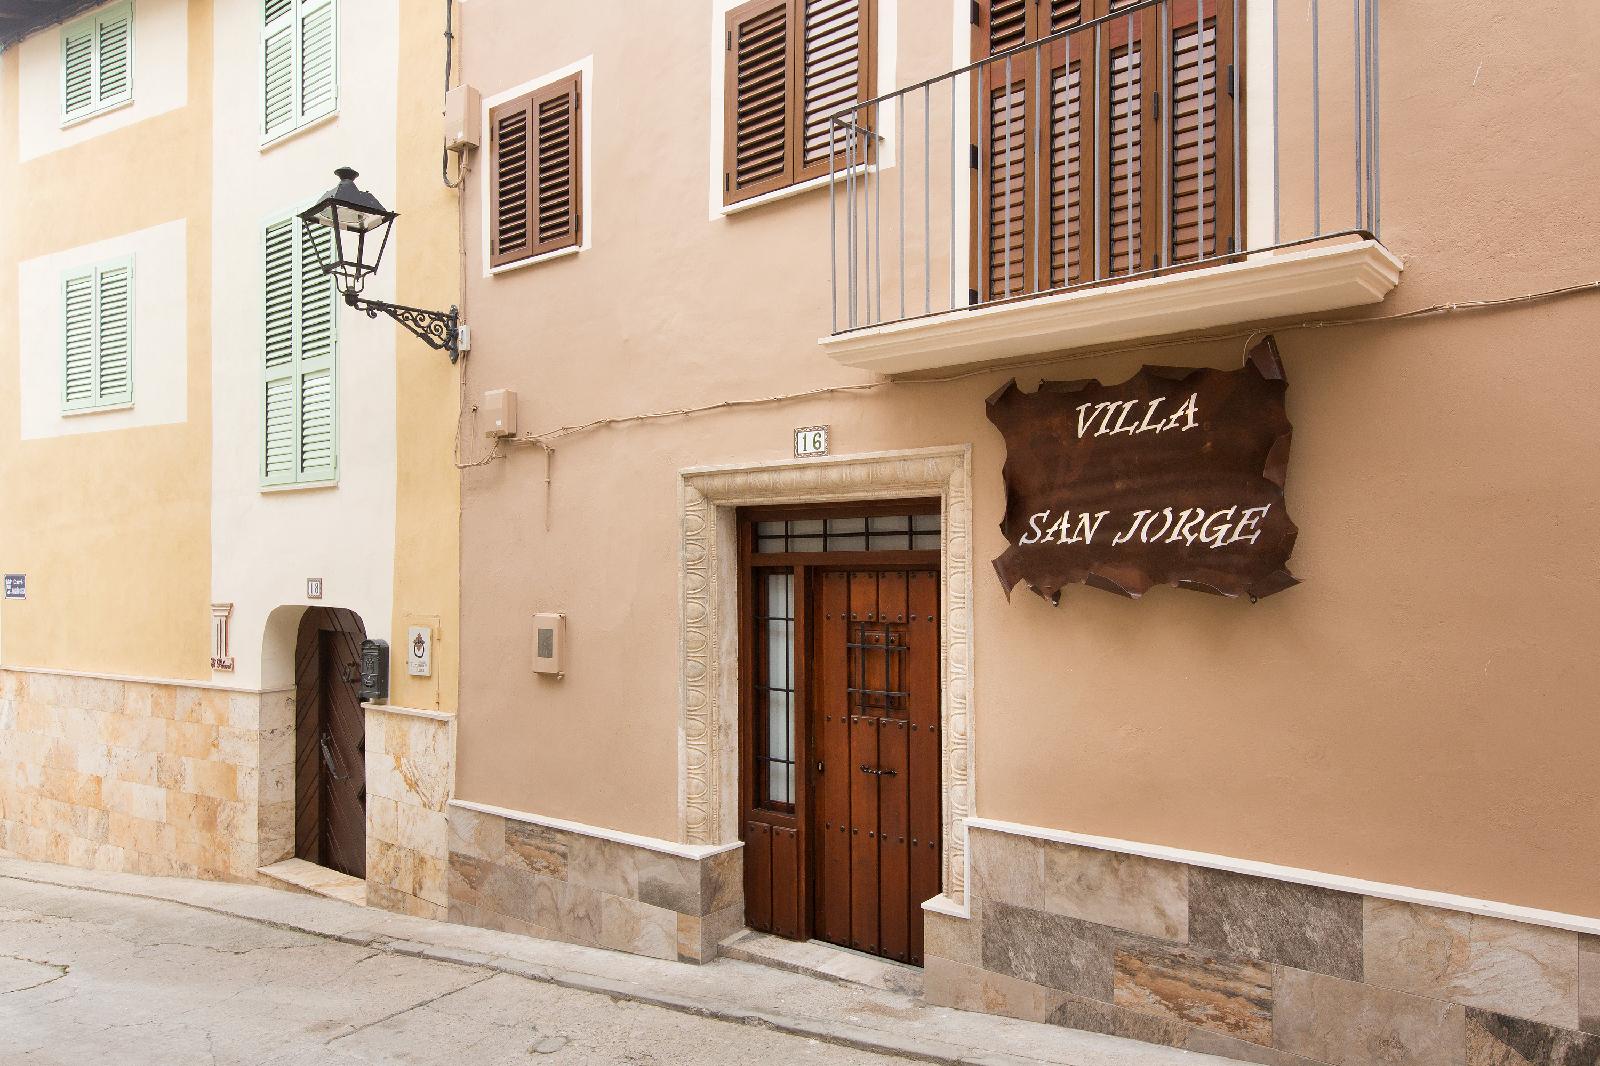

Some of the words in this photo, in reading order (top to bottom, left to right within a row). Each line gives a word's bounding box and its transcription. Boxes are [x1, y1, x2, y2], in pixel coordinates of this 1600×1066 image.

[1076, 393, 1199, 438] VILLA
[803, 432, 821, 452] 16
[1018, 510, 1110, 547] SAN
[1112, 503, 1271, 549] JORGE
